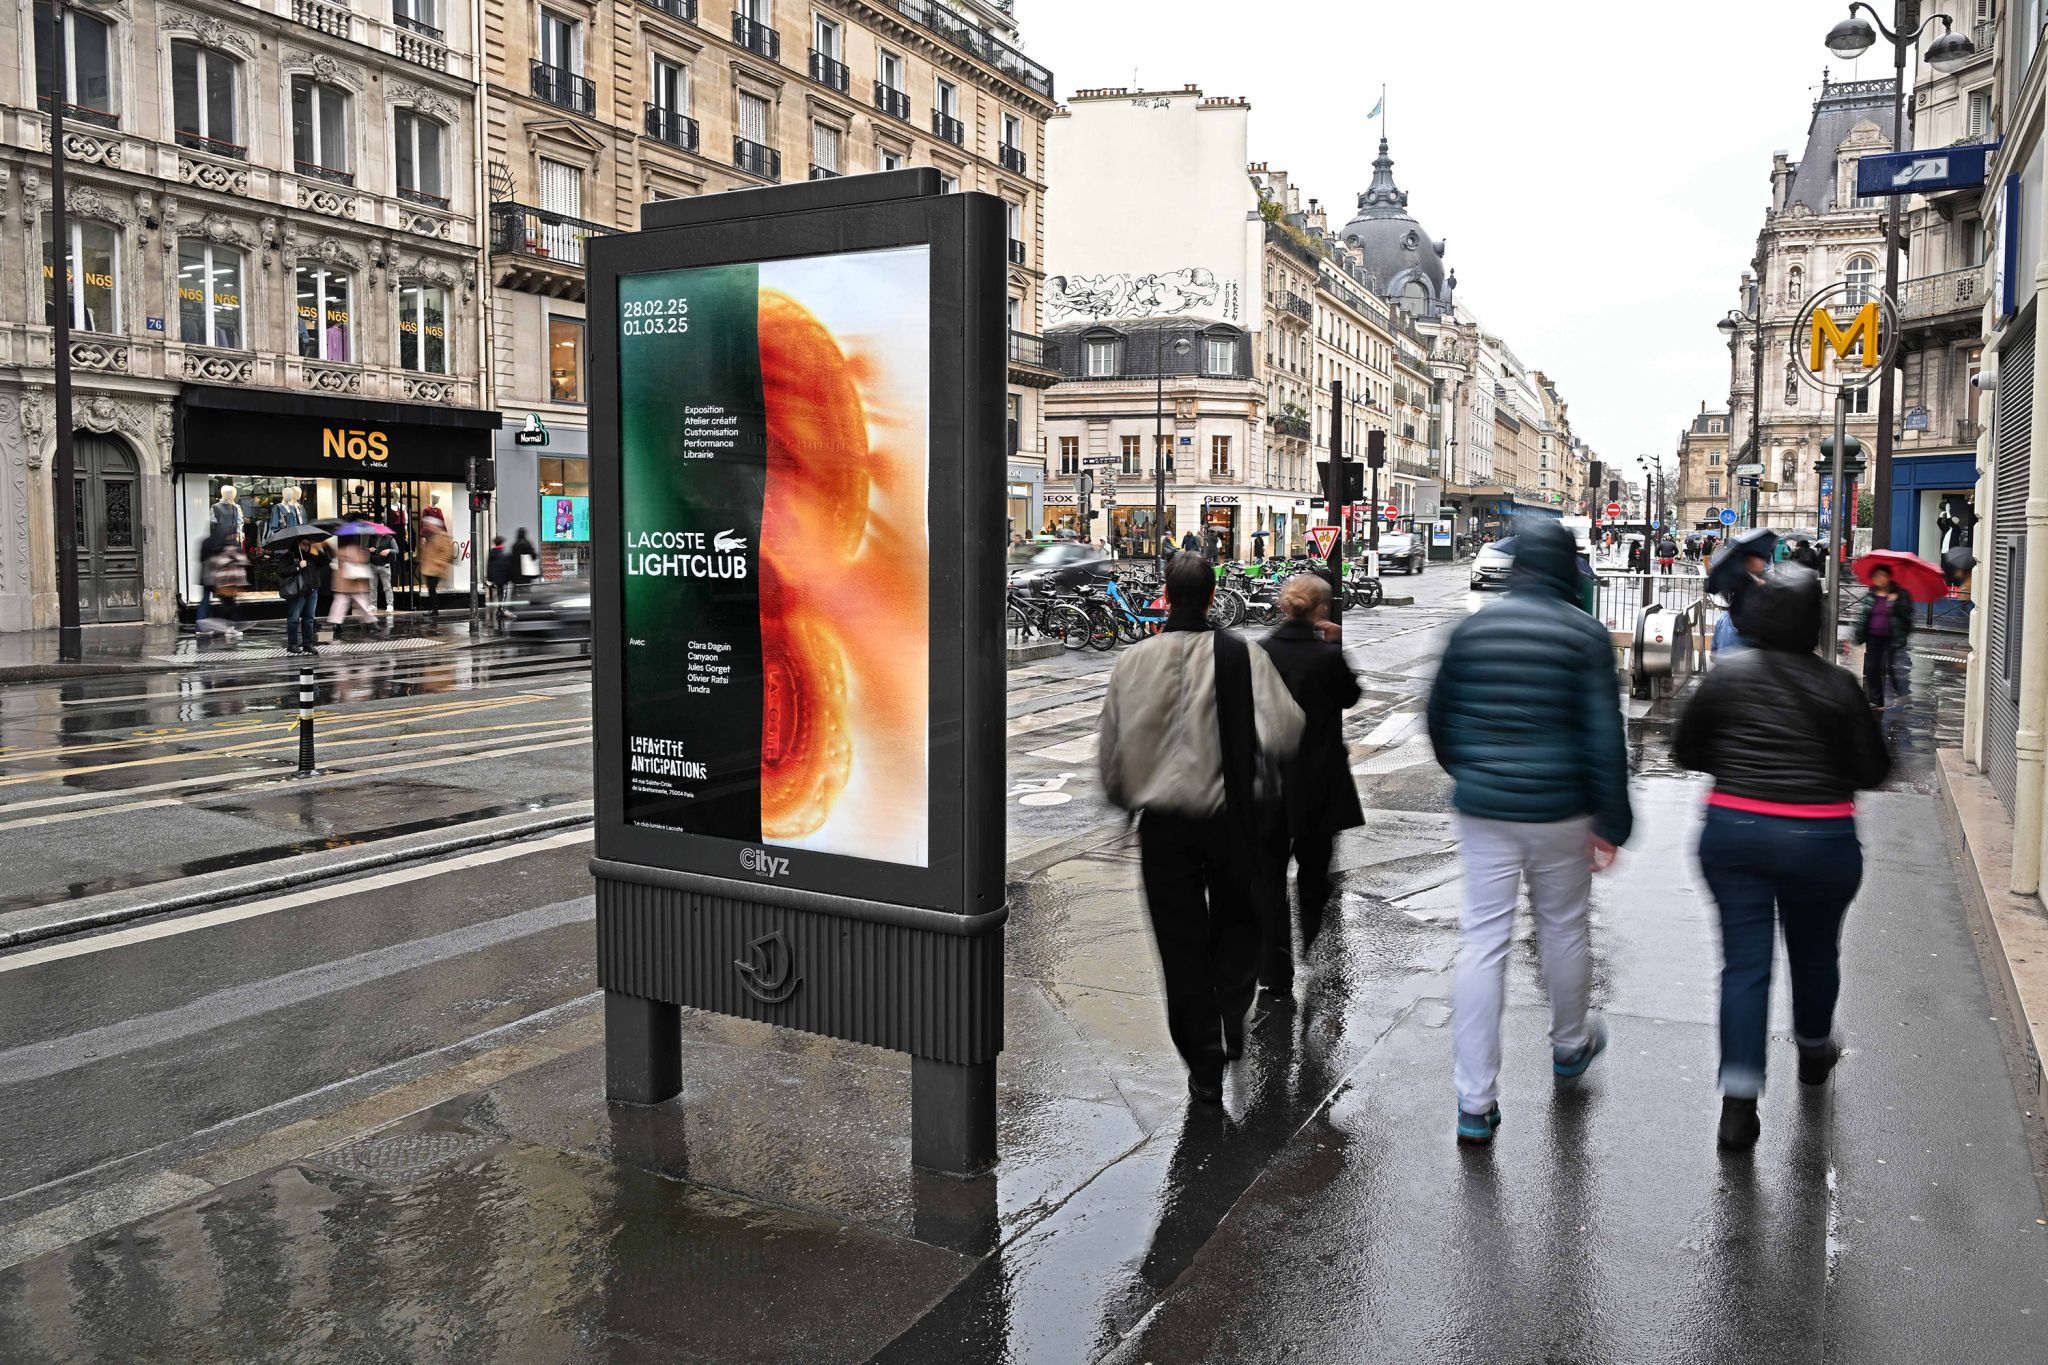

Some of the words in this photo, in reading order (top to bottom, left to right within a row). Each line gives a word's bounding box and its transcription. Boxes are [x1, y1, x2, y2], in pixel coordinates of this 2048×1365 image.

[43, 265, 74, 285] NS
[623, 298, 688, 317] 28.02.25
[149, 319, 162, 329] 76
[623, 317, 688, 336] 01.03.25
[1811, 303, 1879, 372] M
[685, 405, 724, 415] Exposition
[684, 416, 710, 425] Atelier
[711, 416, 737, 425] créatif
[684, 427, 739, 436] Customisation
[520, 433, 542, 443] Normal
[684, 439, 734, 447] Performance
[323, 428, 389, 461] NōS
[683, 450, 714, 458] Librairie
[1203, 495, 1239, 504] GEOX
[627, 531, 706, 550] LACOSTE
[627, 552, 748, 579] LIGHTCLUB
[629, 637, 646, 646] Avec
[687, 641, 707, 650] Clara
[707, 642, 732, 653] Daguin
[687, 652, 719, 662] Canyaon
[687, 663, 704, 672] Jules
[705, 664, 731, 675] Gorget
[687, 673, 709, 683] Olivier
[711, 675, 729, 684] Ratsi
[687, 684, 710, 694] Tundra
[739, 847, 790, 878] Cityz
